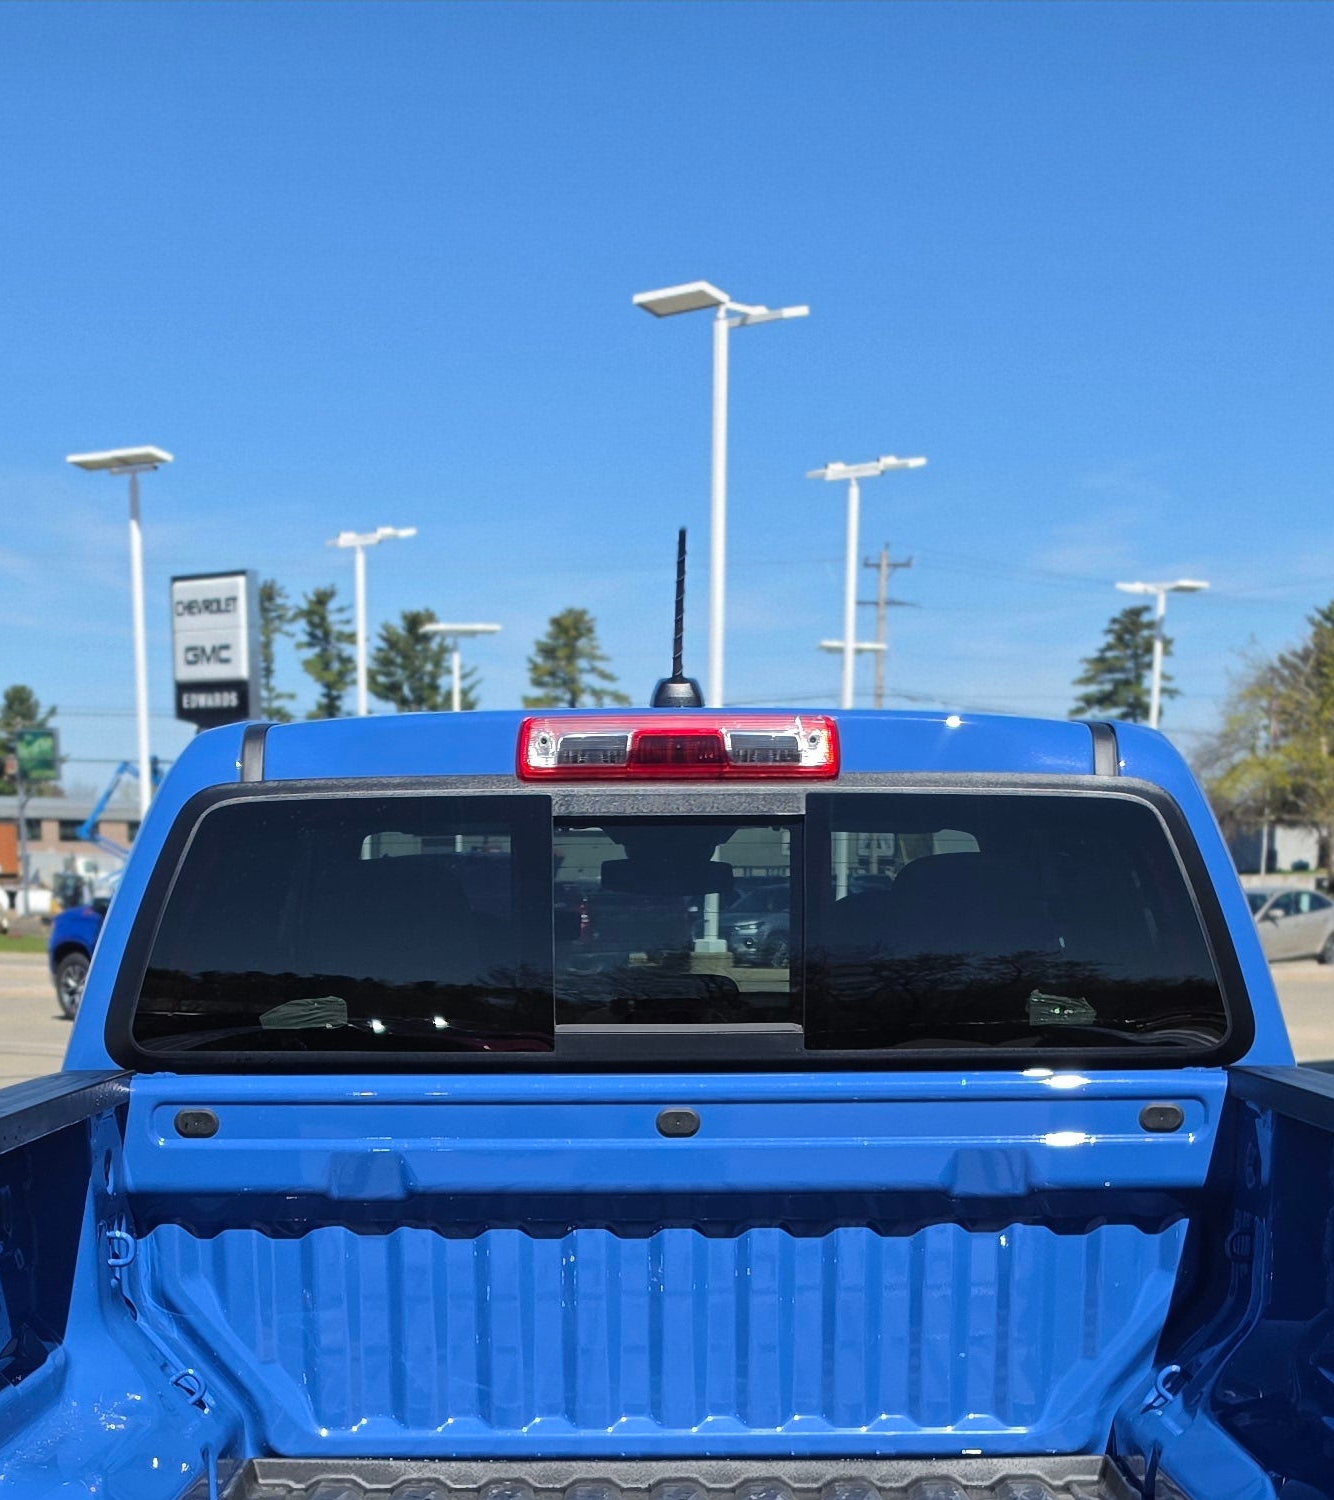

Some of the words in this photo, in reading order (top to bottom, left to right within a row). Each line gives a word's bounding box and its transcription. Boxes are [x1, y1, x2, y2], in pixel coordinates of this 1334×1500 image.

[175, 597, 238, 616] CHEVROLET
[184, 644, 232, 666] GMC
[182, 691, 238, 709] EDWARDS
